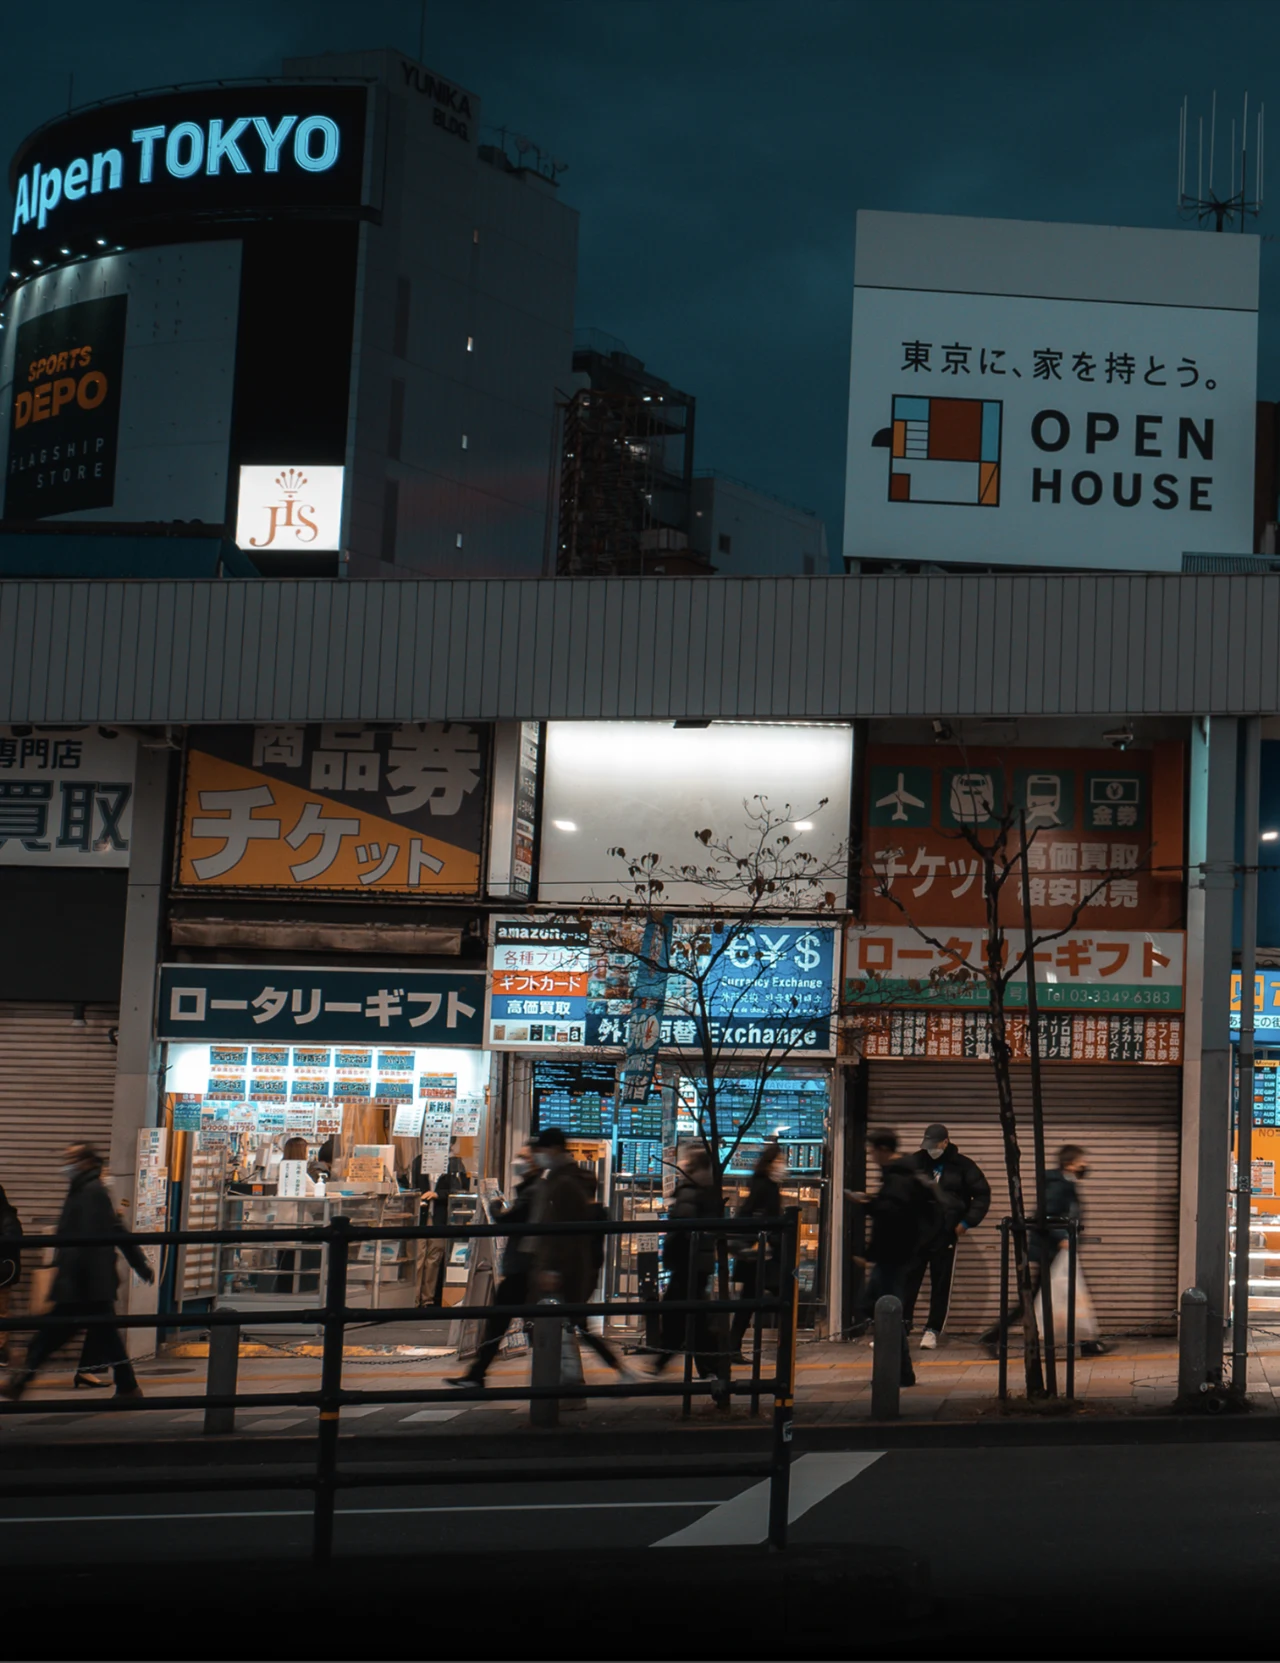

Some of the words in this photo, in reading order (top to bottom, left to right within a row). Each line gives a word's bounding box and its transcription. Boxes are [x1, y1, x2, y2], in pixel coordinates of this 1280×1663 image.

[401, 60, 473, 119] YUNIKA
[12, 148, 122, 235] Alpen
[132, 114, 340, 184] TOKYO
[27, 345, 93, 382] SPORTS
[900, 339, 1218, 392] 東京に、家を持とう。
[14, 370, 108, 431] DEPO
[1030, 409, 1215, 461] OPEN
[10, 437, 106, 475] FLAGSHIP
[37, 462, 104, 490] STORE
[1031, 467, 1214, 512] HOUSE
[0, 779, 132, 853] 買取
[1091, 805, 1138, 827] 金券
[190, 784, 446, 889] チケット
[1017, 842, 1139, 873] 高価買取
[1017, 878, 1139, 909] 格安販売
[497, 926, 561, 940] amazon
[858, 937, 1172, 979] ロータリーギフト
[499, 974, 582, 992] ギフトカード
[772, 976, 823, 989] Exchange
[169, 985, 477, 1029] ロータリーギフト
[506, 999, 572, 1016] 高価買取
[597, 1017, 698, 1045] 外替
[1121, 1016, 1132, 1060] クオカード
[1258, 1129, 1275, 1138] NO
